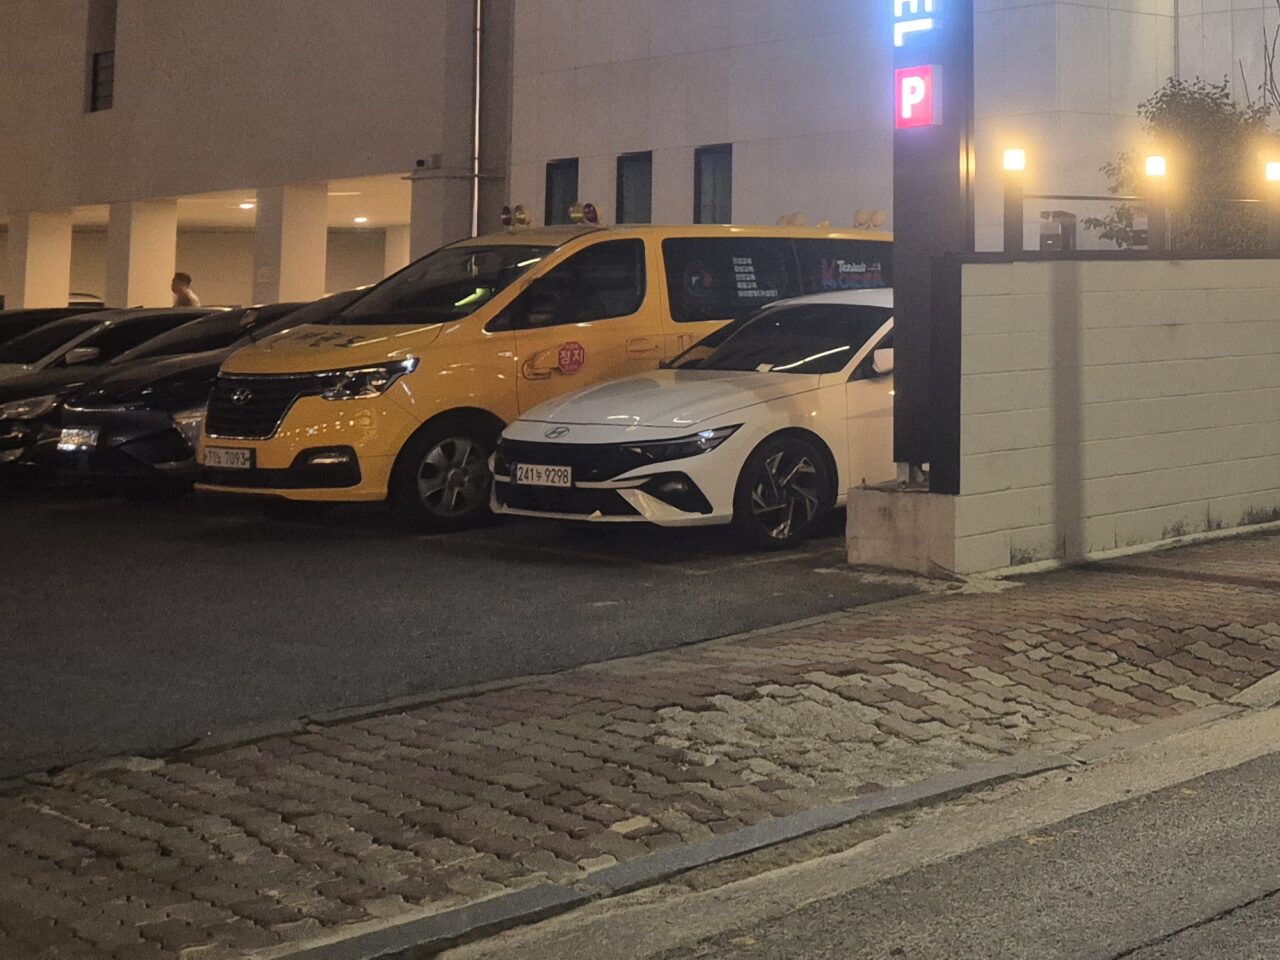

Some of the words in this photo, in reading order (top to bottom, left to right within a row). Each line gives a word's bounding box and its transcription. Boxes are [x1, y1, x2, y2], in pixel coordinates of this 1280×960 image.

[901, 76, 925, 119] P
[560, 349, 583, 364] 정지
[518, 466, 542, 481] 241누
[545, 468, 569, 484] 9298
